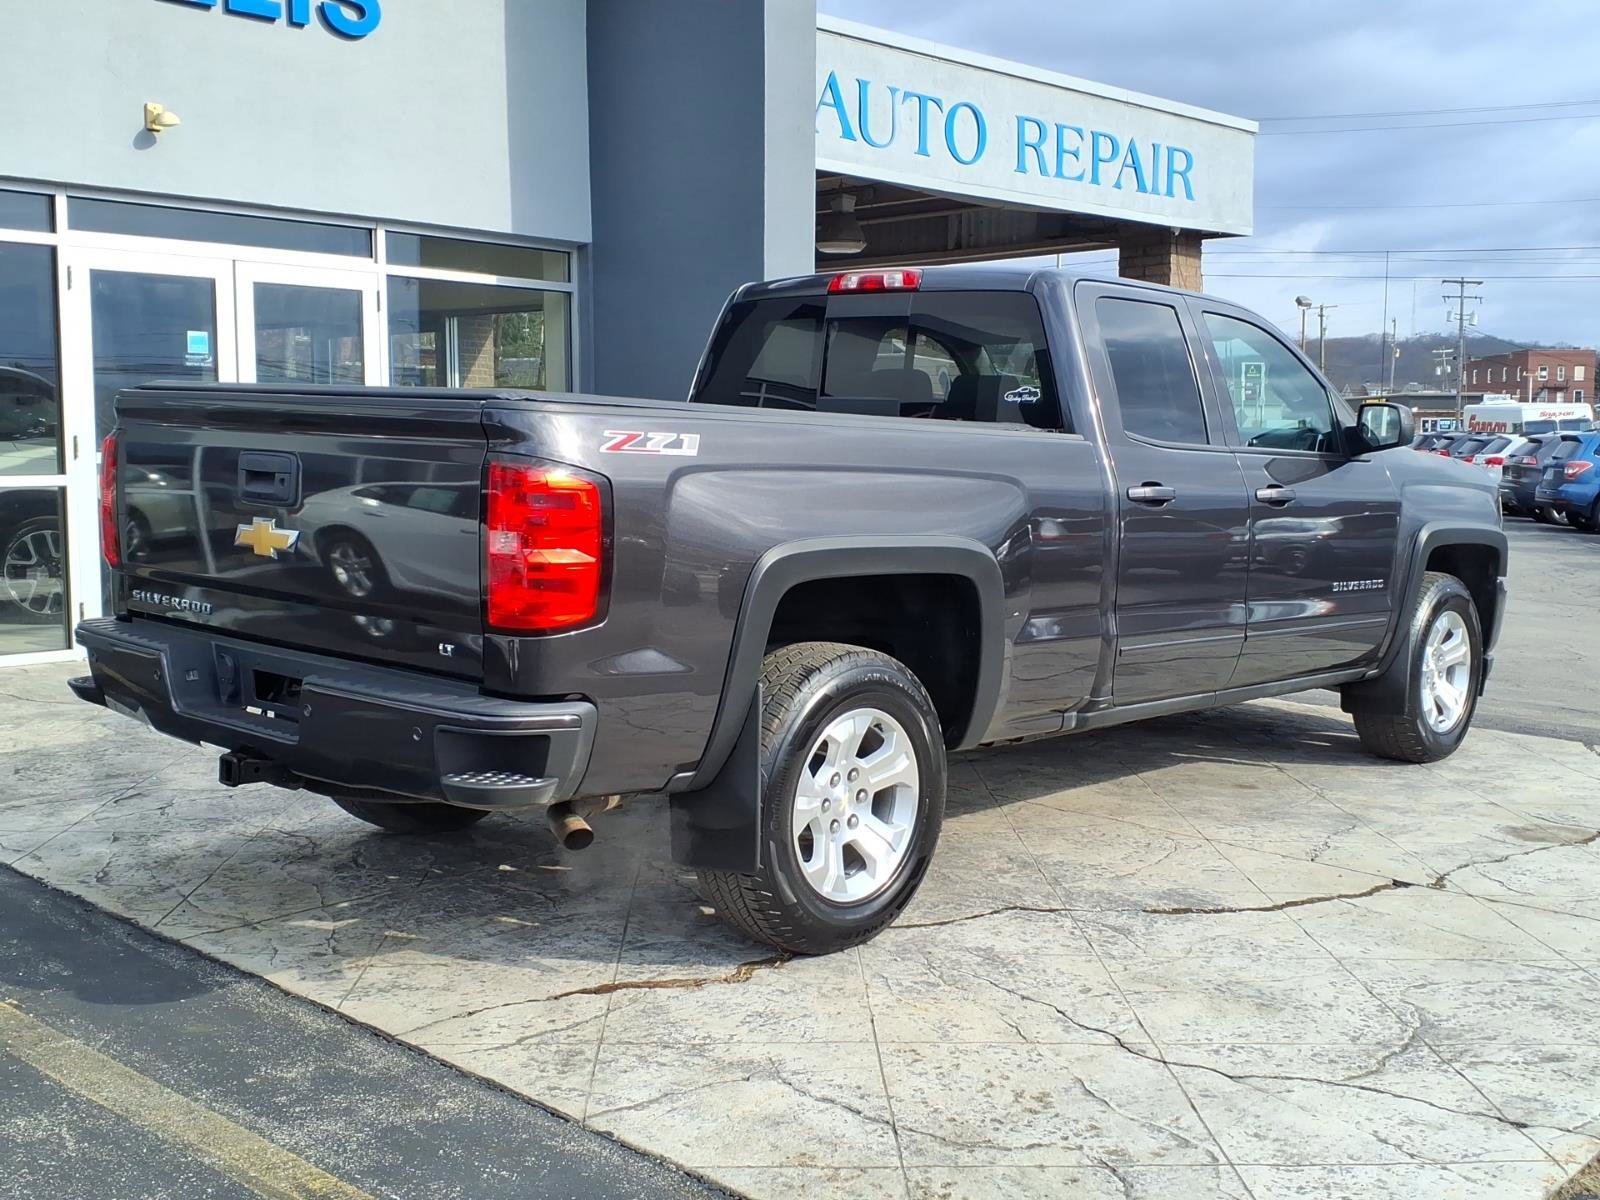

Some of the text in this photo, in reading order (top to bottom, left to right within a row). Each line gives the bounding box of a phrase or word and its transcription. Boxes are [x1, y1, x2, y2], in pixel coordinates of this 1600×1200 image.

[816, 70, 1196, 201] AUTO REPAIR
[600, 430, 701, 456] Z71
[1332, 579, 1384, 591] SILVERADO
[132, 589, 212, 615] SILVERADO
[439, 643, 455, 657] LT
